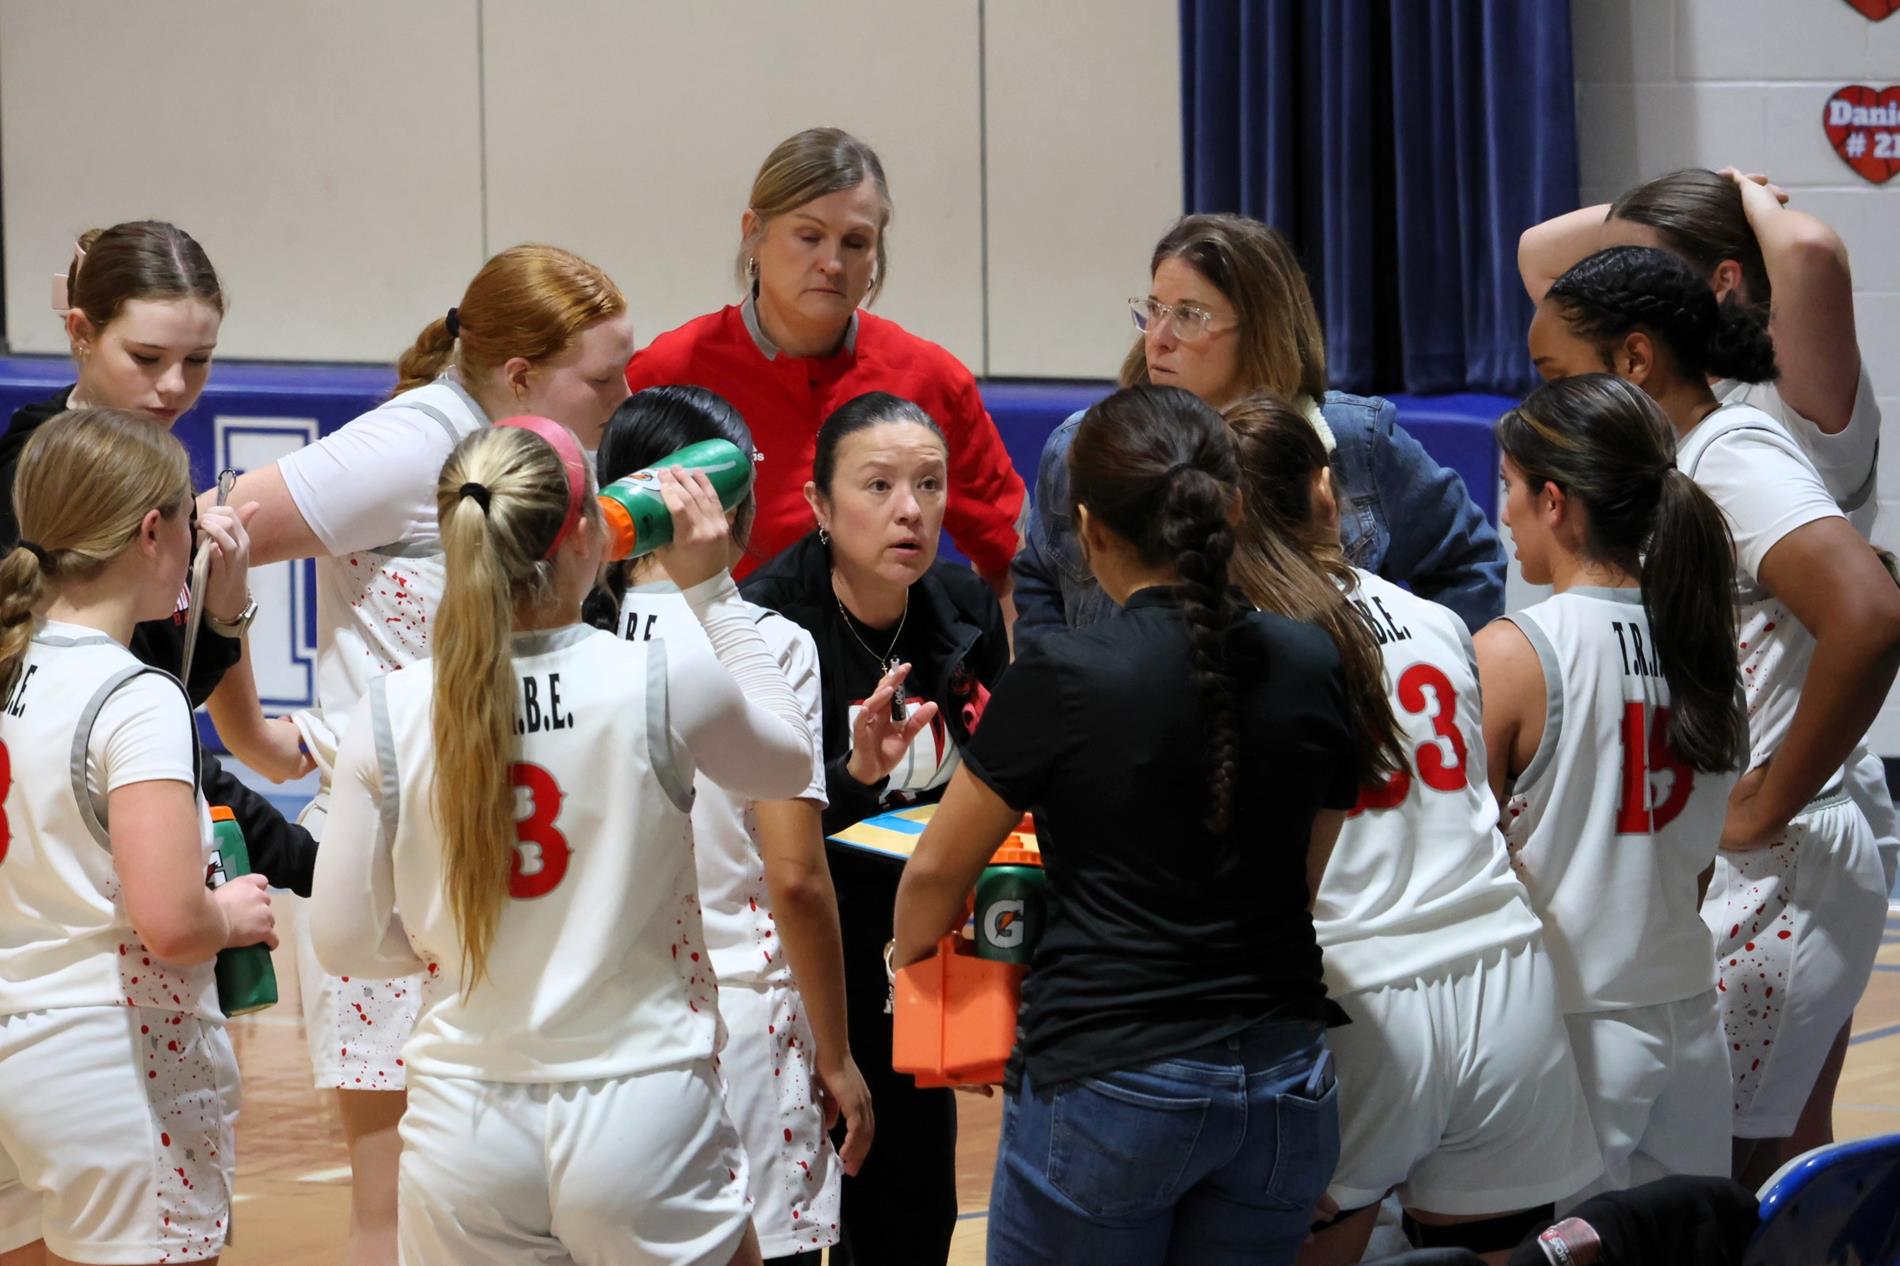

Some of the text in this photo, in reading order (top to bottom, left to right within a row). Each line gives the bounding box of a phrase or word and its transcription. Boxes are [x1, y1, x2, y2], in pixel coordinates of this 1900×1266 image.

[1830, 101, 1900, 126] Dani
[1846, 131, 1867, 158] #
[1352, 596, 1412, 645] B.E.
[512, 673, 574, 735] .B.E.
[984, 899, 1025, 949] G
